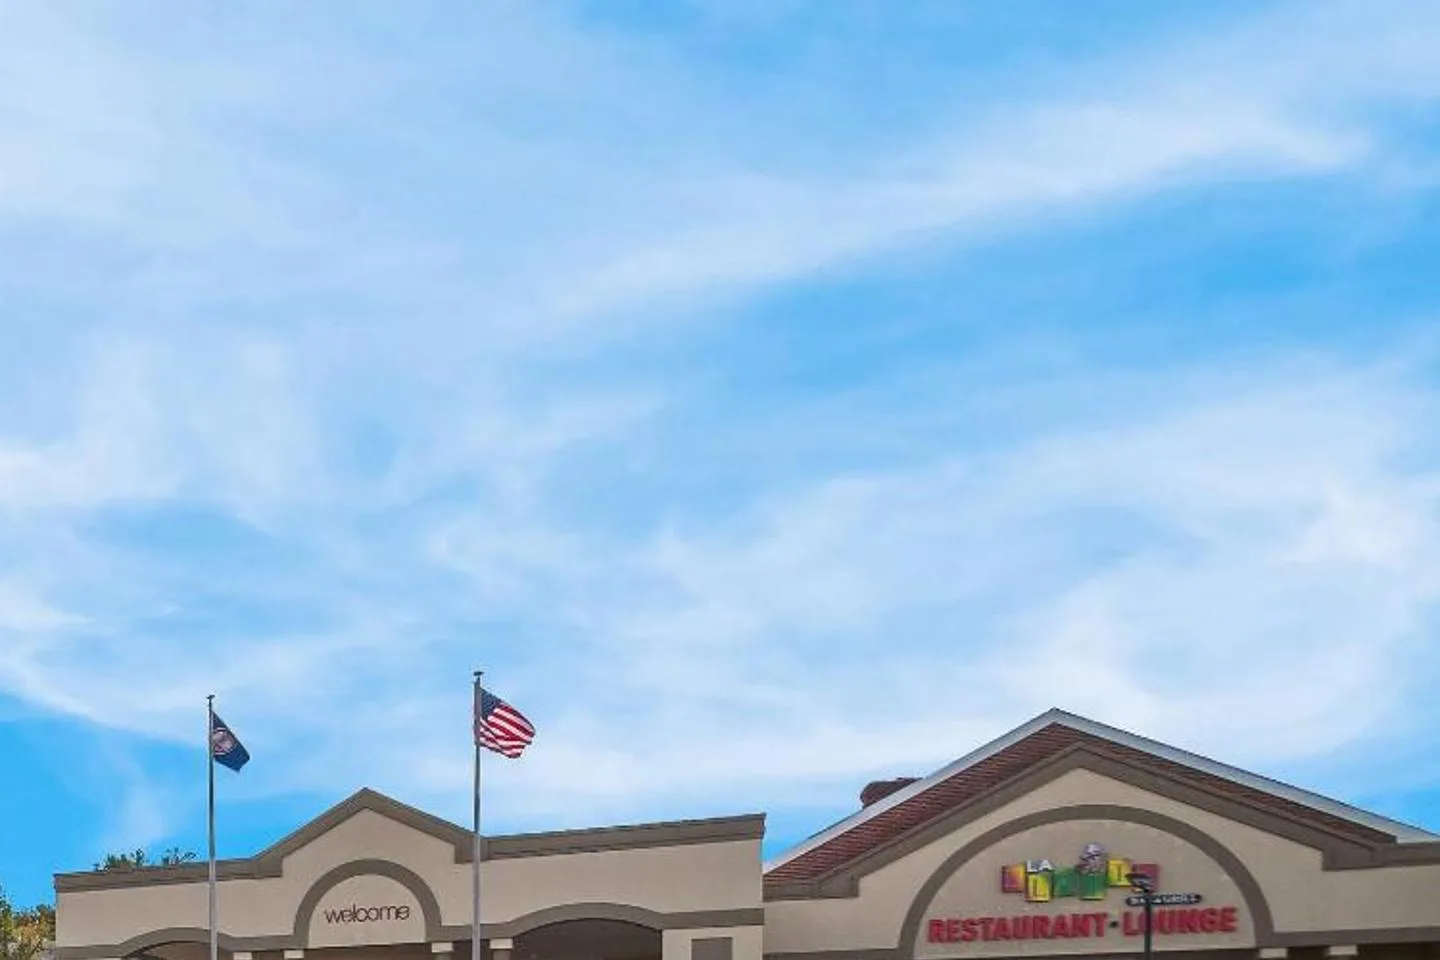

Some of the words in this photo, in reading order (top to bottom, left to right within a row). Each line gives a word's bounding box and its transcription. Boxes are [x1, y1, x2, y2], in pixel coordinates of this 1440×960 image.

[323, 903, 410, 923] welcome
[928, 912, 1108, 943] RESTAURANT
[1122, 906, 1237, 936] LOUNGE
